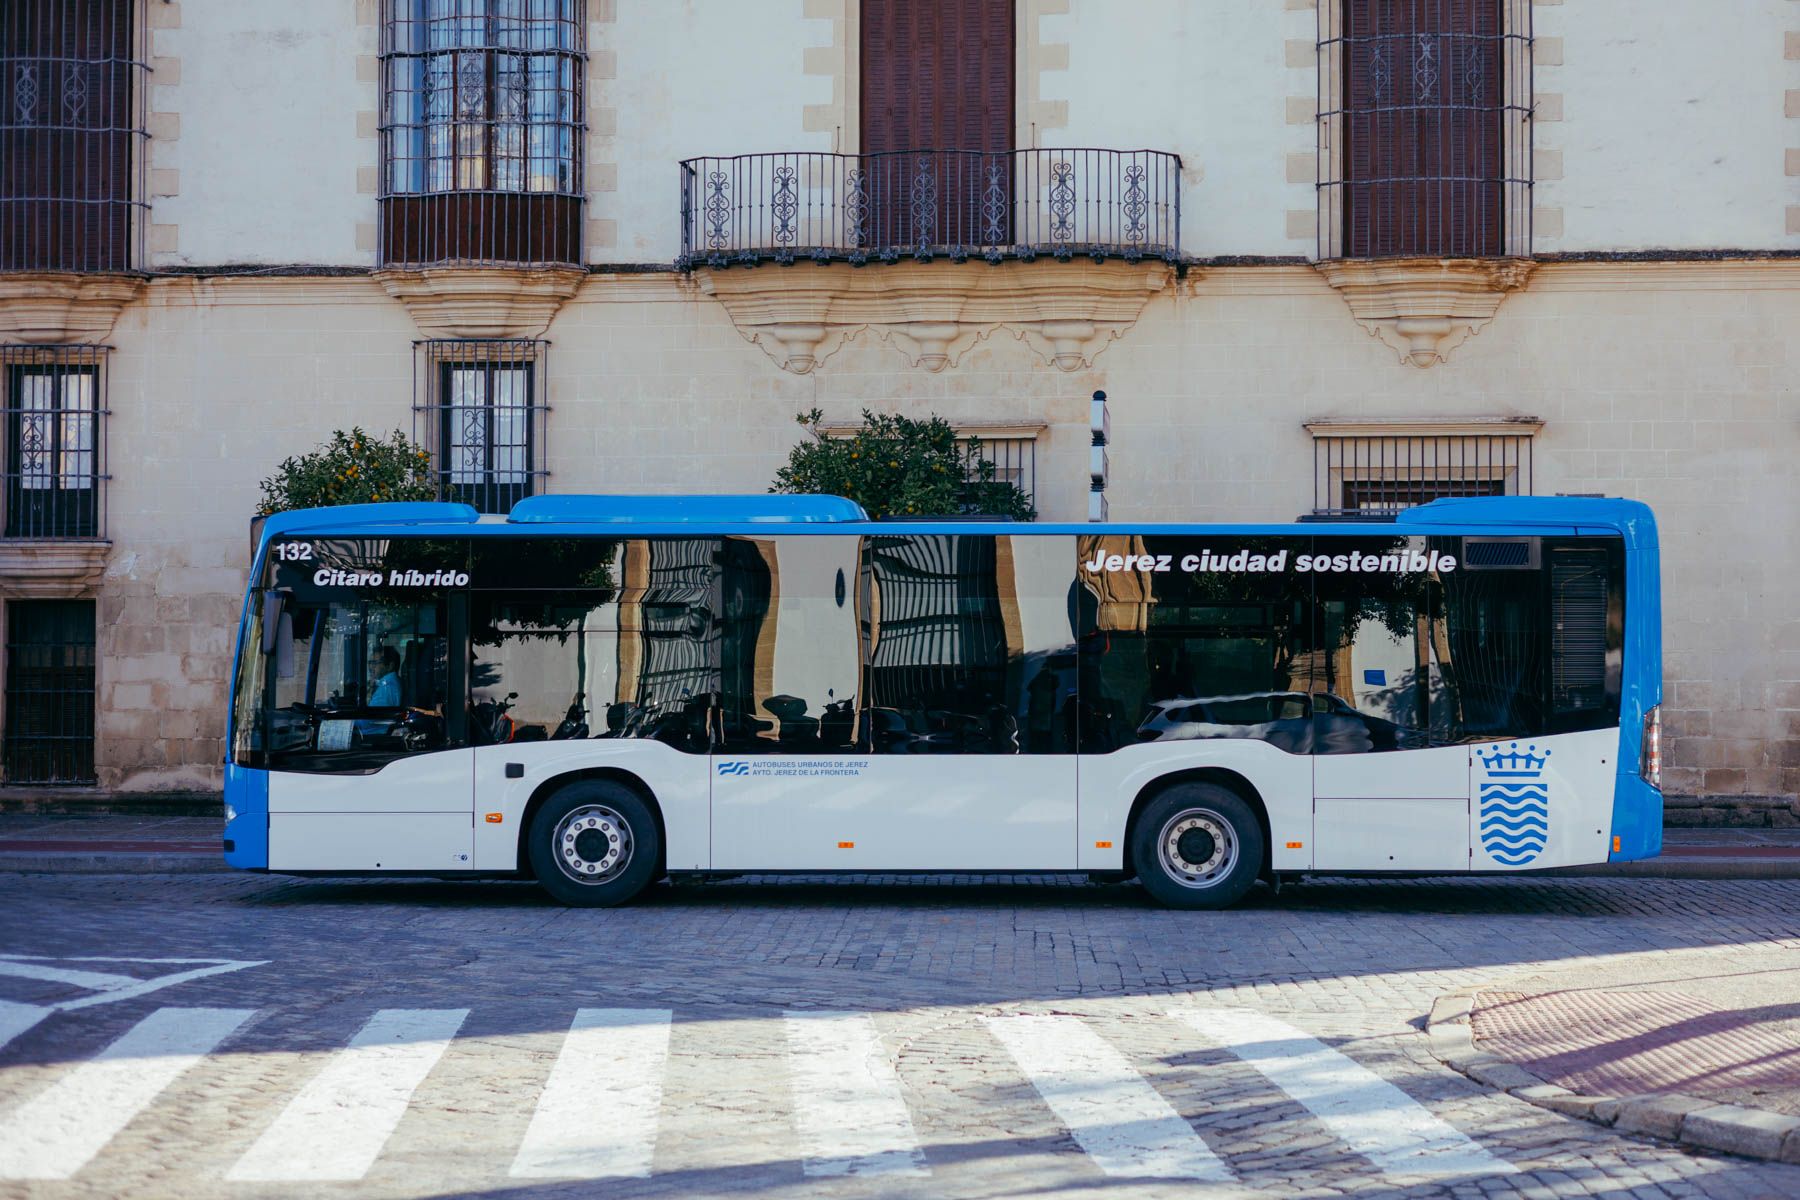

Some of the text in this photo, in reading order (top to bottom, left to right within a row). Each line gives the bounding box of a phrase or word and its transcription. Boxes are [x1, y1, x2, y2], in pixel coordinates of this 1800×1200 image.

[276, 543, 312, 560] 132
[1086, 549, 1457, 572] Jerez ciudad sostenible
[313, 569, 469, 586] Citaro híbrido
